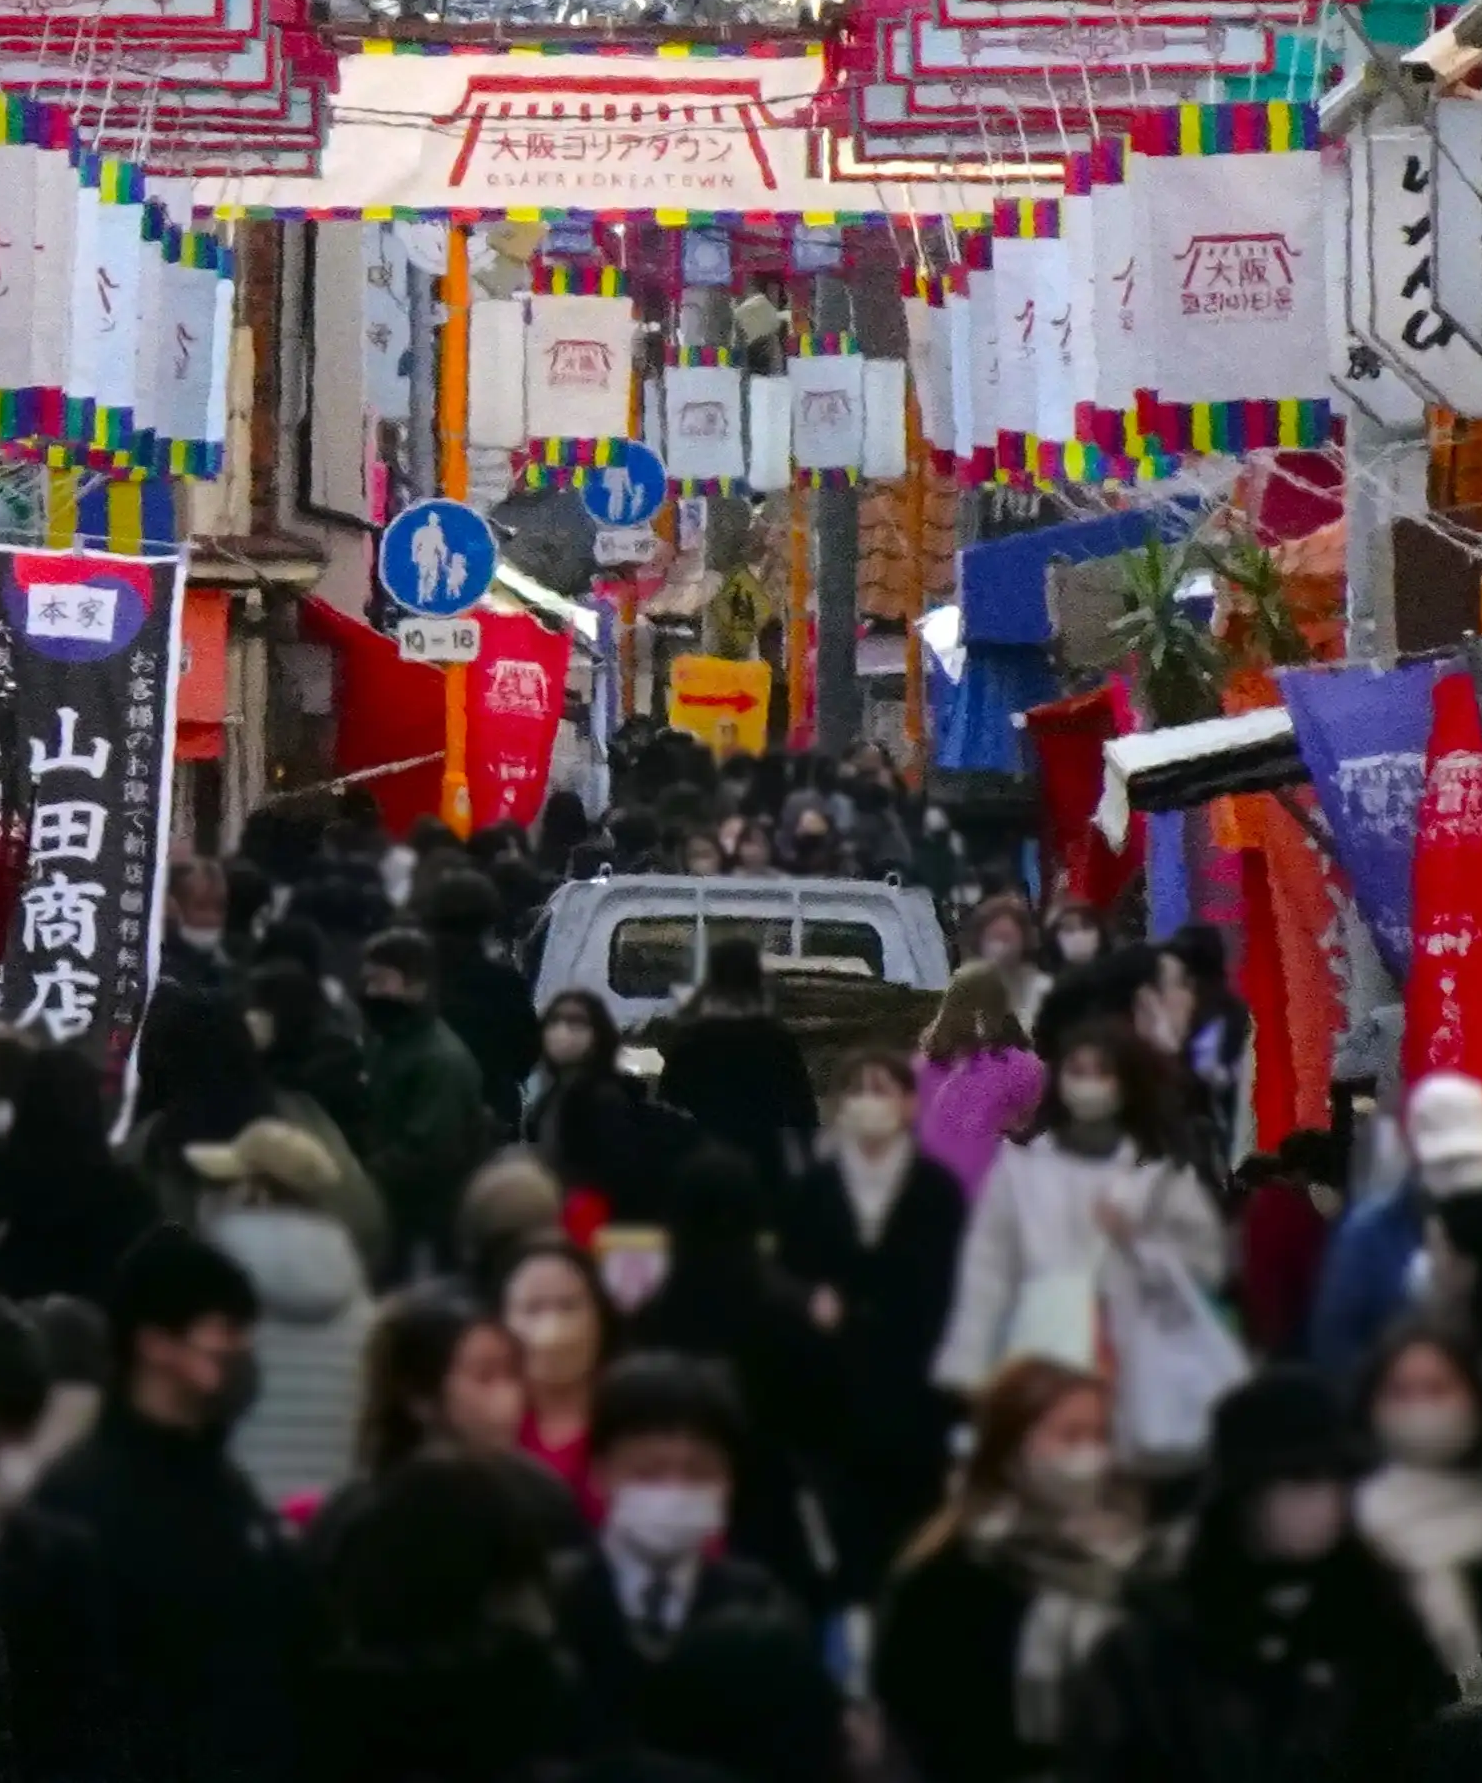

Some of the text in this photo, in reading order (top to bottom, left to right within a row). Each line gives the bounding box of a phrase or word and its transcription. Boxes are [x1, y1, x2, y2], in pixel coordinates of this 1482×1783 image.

[491, 132, 732, 162] 大阪コリアタウン
[36, 595, 105, 628] 本家
[14, 706, 112, 1044] 山田商店
